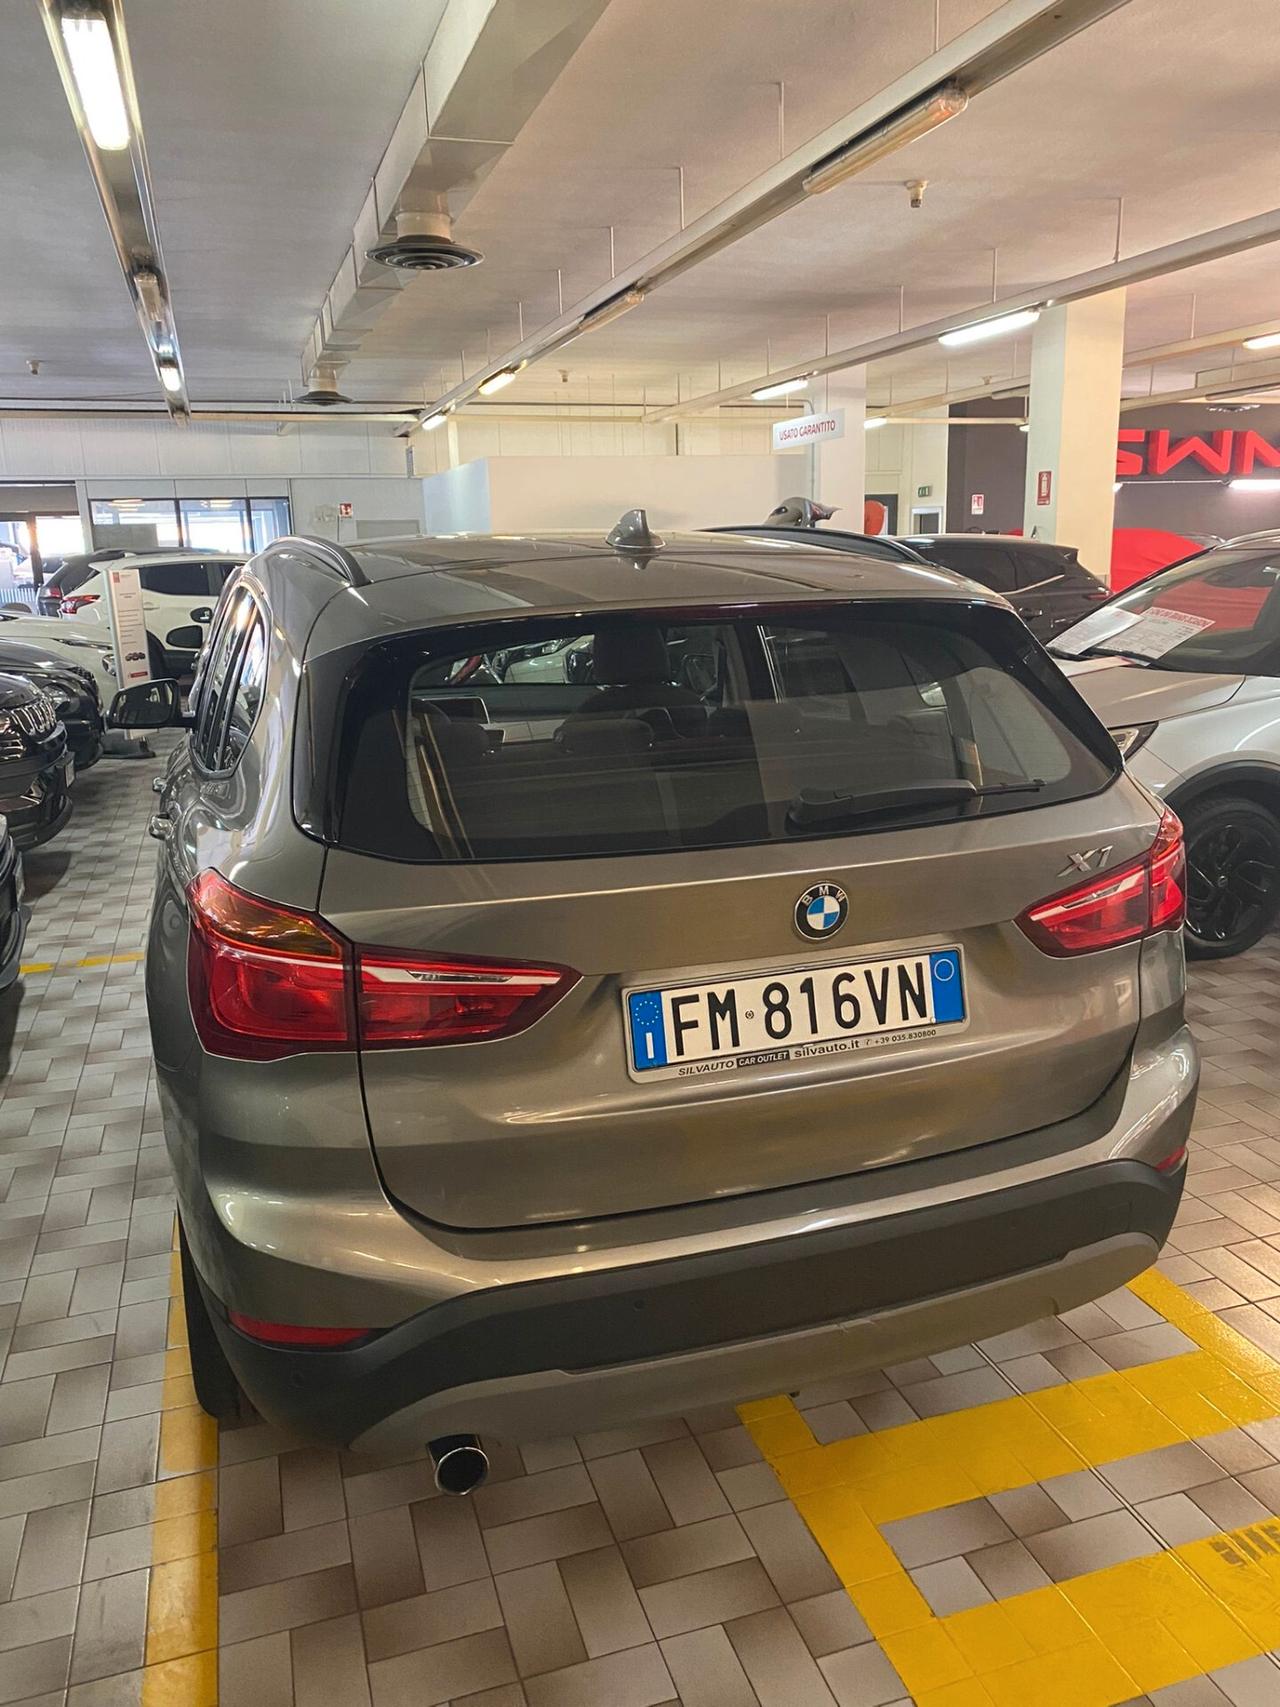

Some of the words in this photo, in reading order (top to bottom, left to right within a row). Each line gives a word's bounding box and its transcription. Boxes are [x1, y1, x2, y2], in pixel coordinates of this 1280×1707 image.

[779, 427, 798, 441] USATO
[1057, 844, 1114, 877] X1
[801, 885, 846, 906] BMW
[671, 988, 740, 1056] FM
[762, 961, 928, 1040] 816VN
[678, 1060, 735, 1076] SILVAUTO
[739, 1056, 756, 1066] CAR
[757, 1051, 788, 1063] OUTLET
[794, 1040, 860, 1058] silvauto.it
